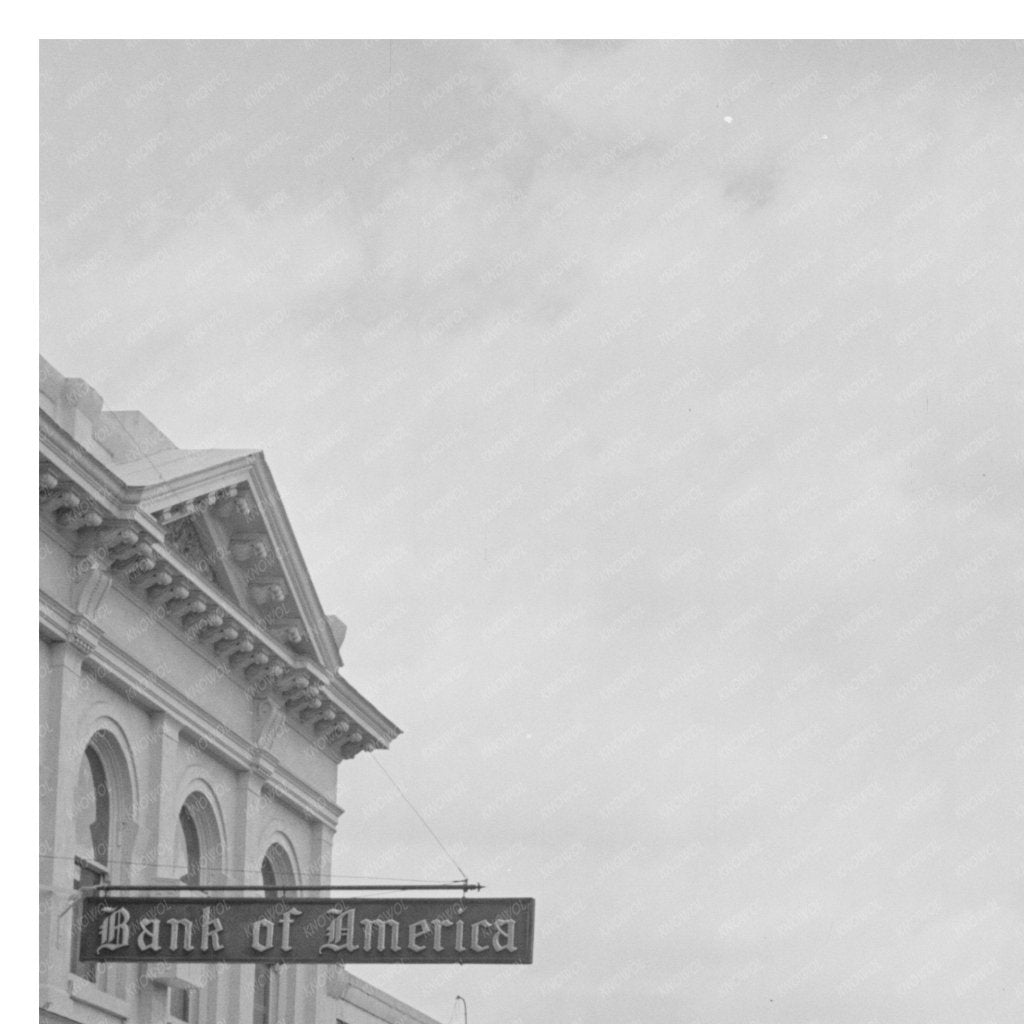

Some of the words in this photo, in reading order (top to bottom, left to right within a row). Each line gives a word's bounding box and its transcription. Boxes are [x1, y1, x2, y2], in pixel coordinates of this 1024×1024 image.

[96, 906, 225, 953] Bank
[251, 907, 302, 953] of
[319, 907, 517, 954] America
